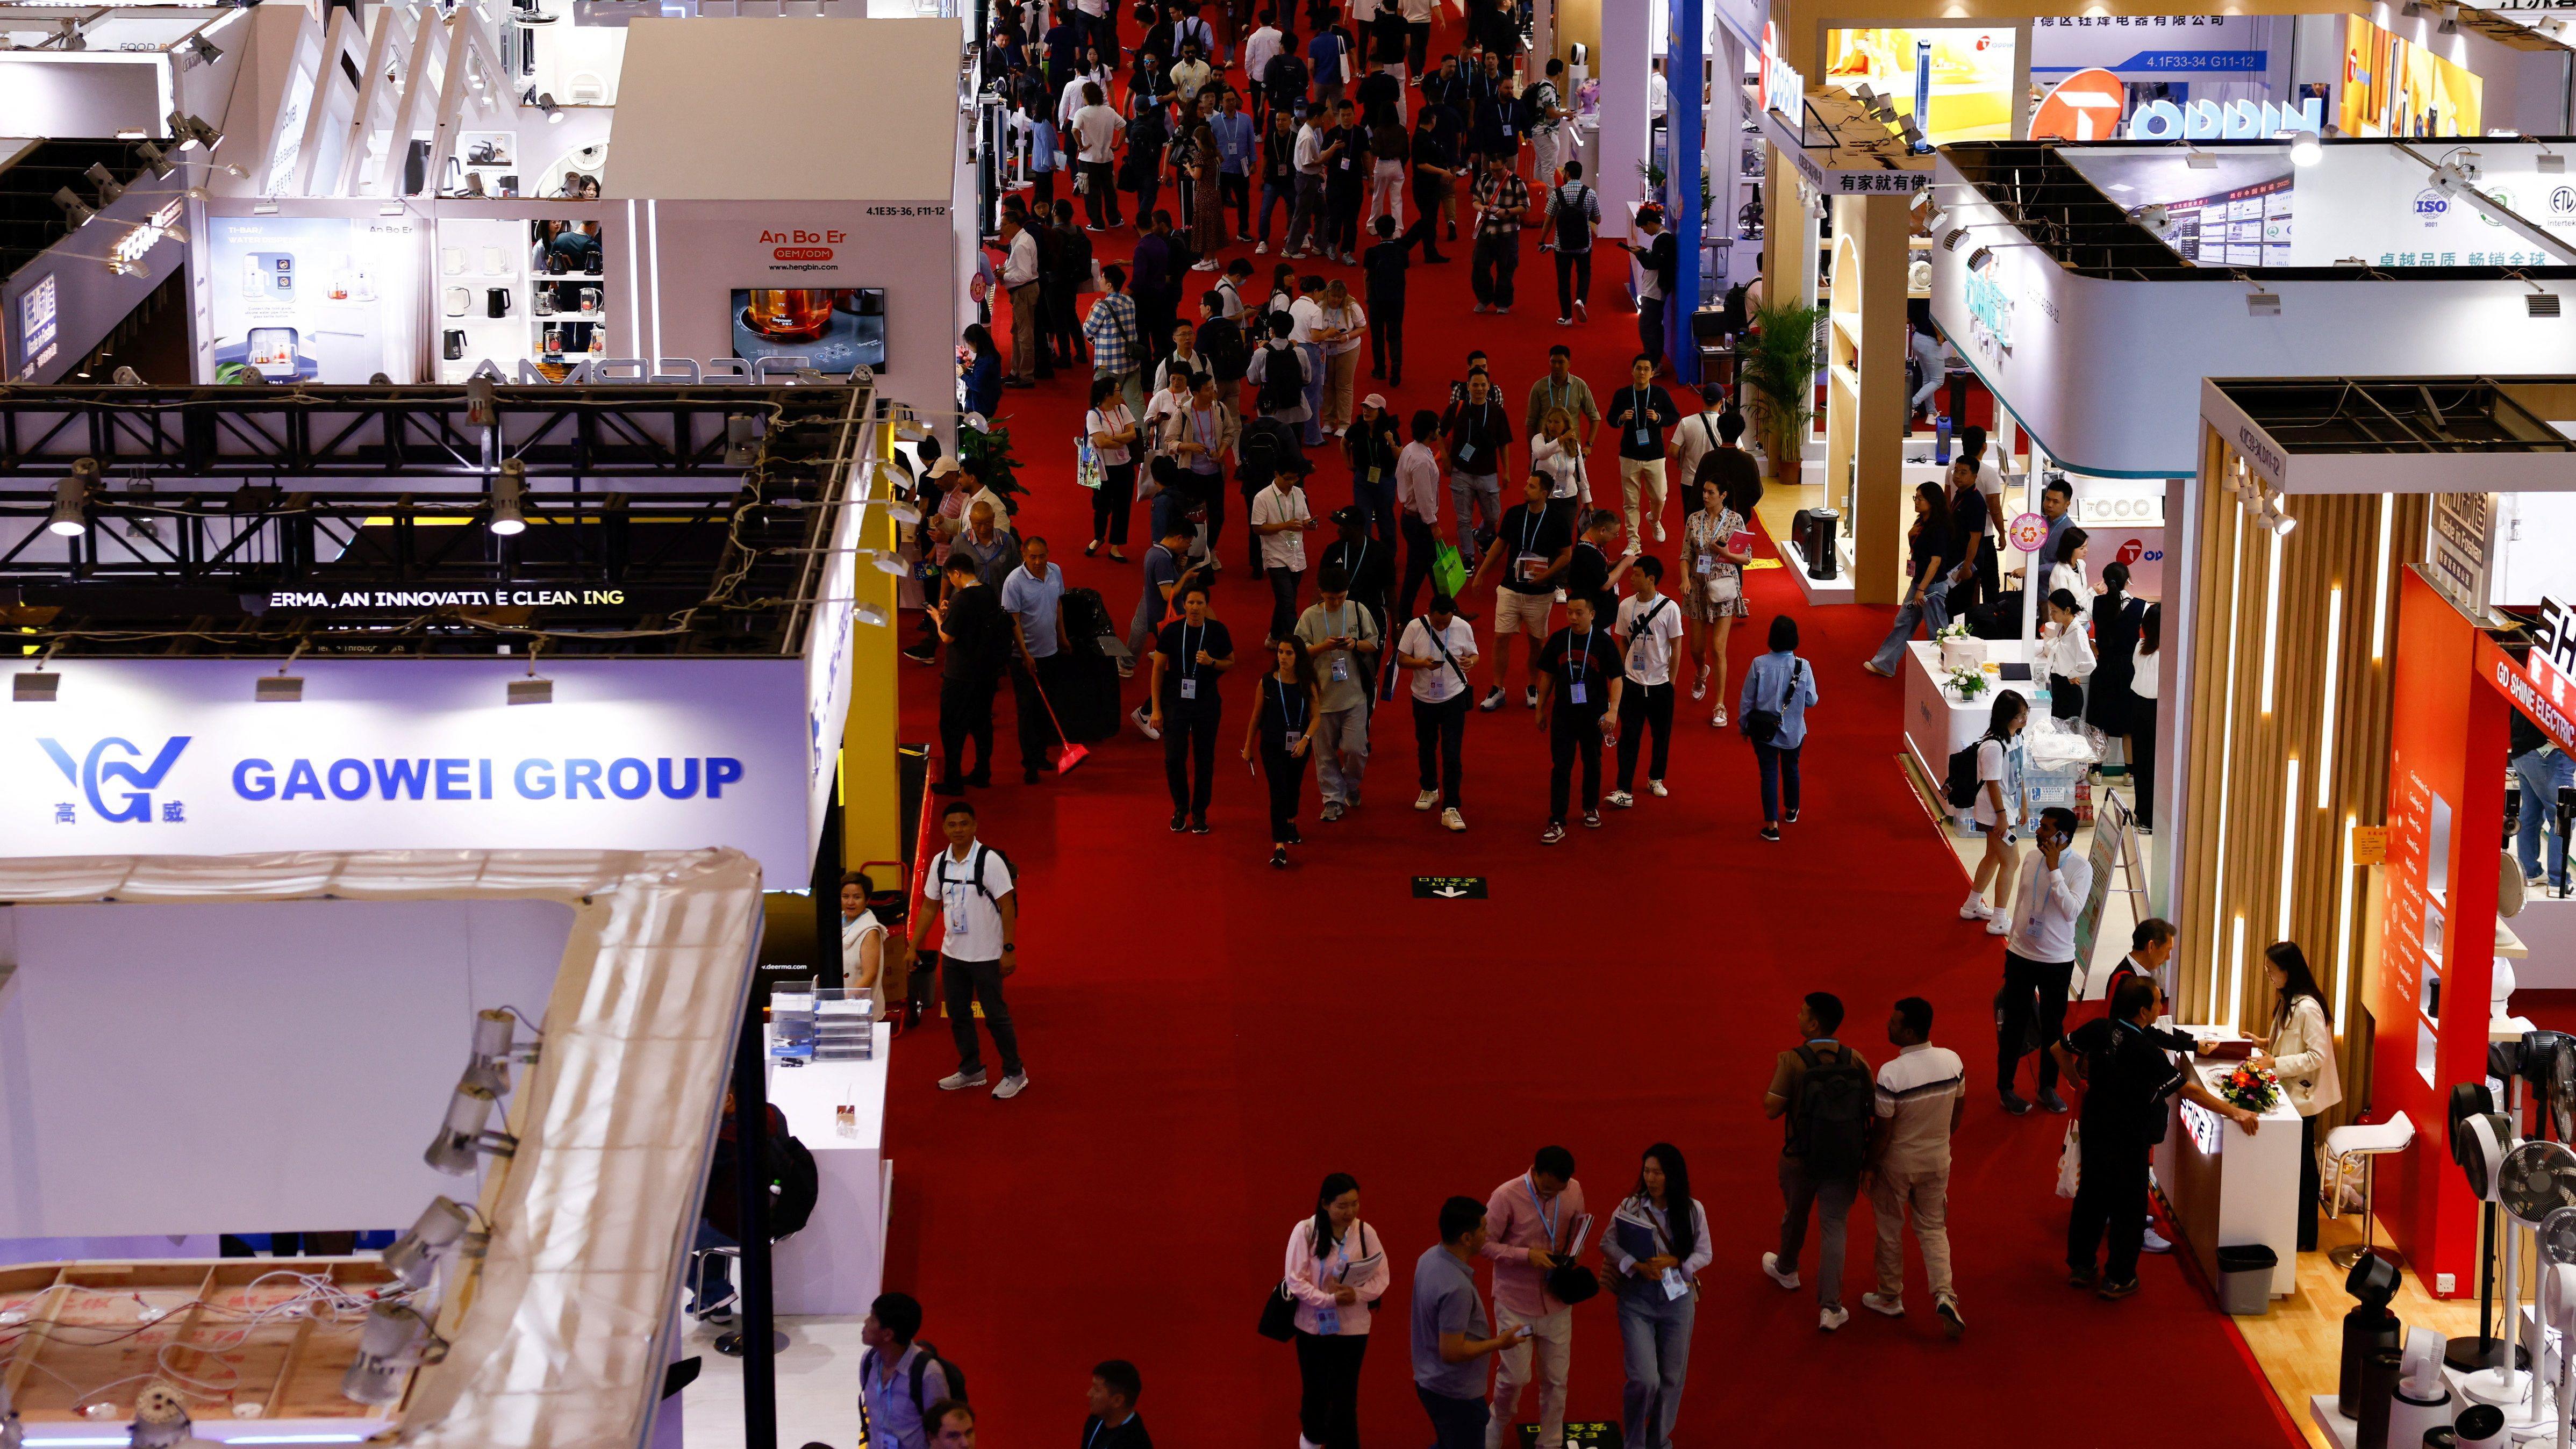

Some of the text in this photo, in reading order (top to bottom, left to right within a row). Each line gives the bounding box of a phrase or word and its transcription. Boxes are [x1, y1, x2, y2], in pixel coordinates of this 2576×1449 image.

[2147, 56, 2254, 67] 4.1F33-34 G11-12
[2277, 180, 2291, 188] 2025
[2416, 200, 2447, 212] ISO
[2553, 190, 2573, 211] ETL
[866, 207, 946, 217] 4.1E35-36, F11-12
[759, 230, 847, 243] An Bo Er
[777, 250, 830, 258] OEM/ODM
[2379, 252, 2546, 267] 卓越品质 畅销全球
[2439, 512, 2455, 541] Made
[2461, 530, 2482, 564] Foshan
[513, 590, 625, 605] CLEANING
[2497, 662, 2510, 688] GD
[2510, 673, 2536, 713] SHINE
[2536, 695, 2575, 748] ELECTRIC
[232, 757, 743, 801] GAOWEI GROUP
[1526, 1423, 1607, 1433] 安全口
